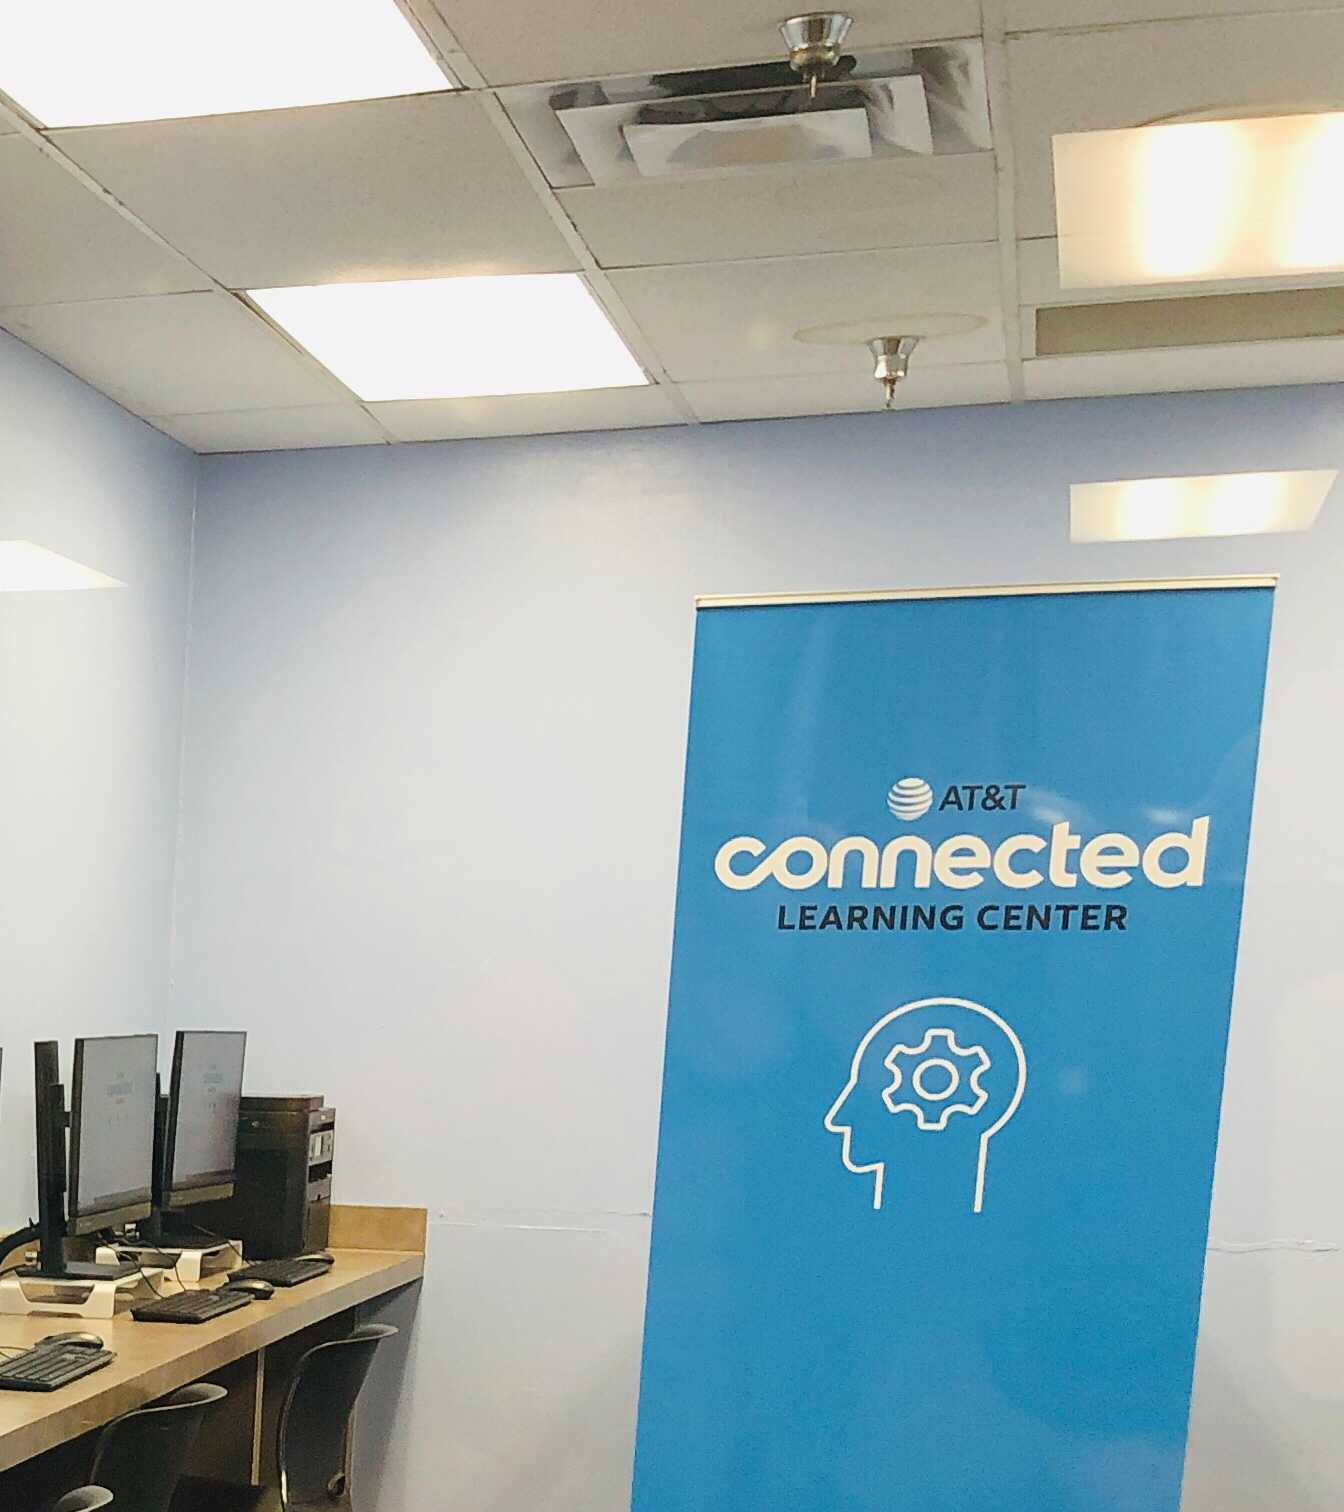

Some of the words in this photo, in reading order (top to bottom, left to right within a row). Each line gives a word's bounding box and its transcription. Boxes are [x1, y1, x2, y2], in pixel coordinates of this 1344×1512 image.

[937, 784, 1026, 812] AT&T
[714, 815, 1210, 890] connected
[777, 904, 964, 931] LEARNING
[977, 904, 1128, 931] CENTER
